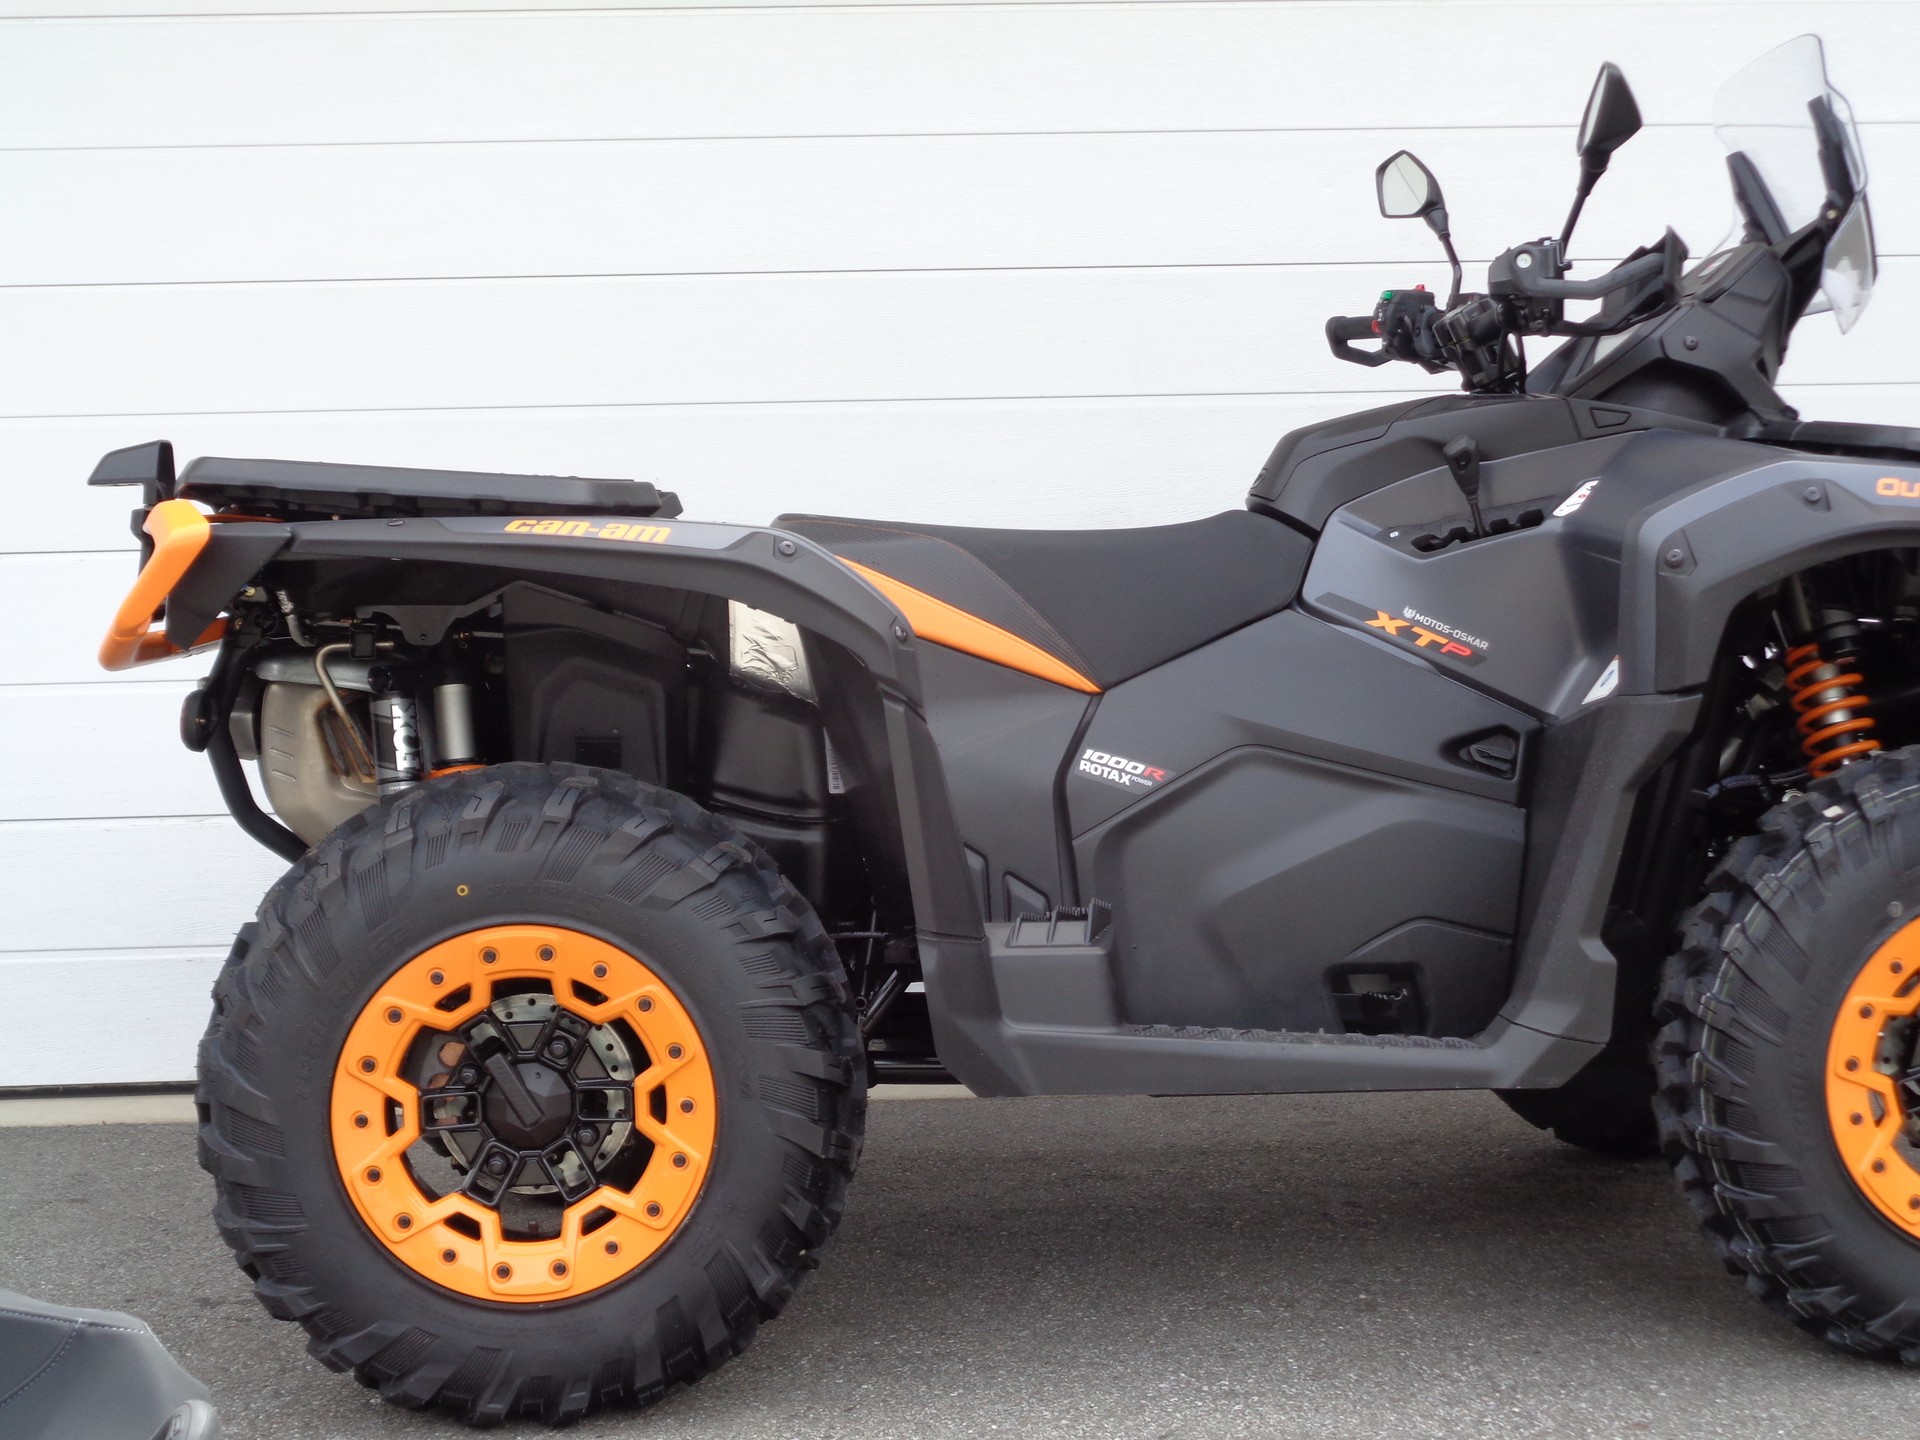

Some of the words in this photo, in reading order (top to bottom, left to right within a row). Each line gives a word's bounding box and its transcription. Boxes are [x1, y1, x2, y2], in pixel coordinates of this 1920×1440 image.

[504, 518, 671, 543] can-am
[1414, 612, 1489, 650] MOTOS-OSKAR
[391, 704, 420, 771] FOX
[1079, 759, 1131, 786] ROTAX
[1131, 775, 1153, 787] POWER
[1082, 748, 1166, 782] 1000R
